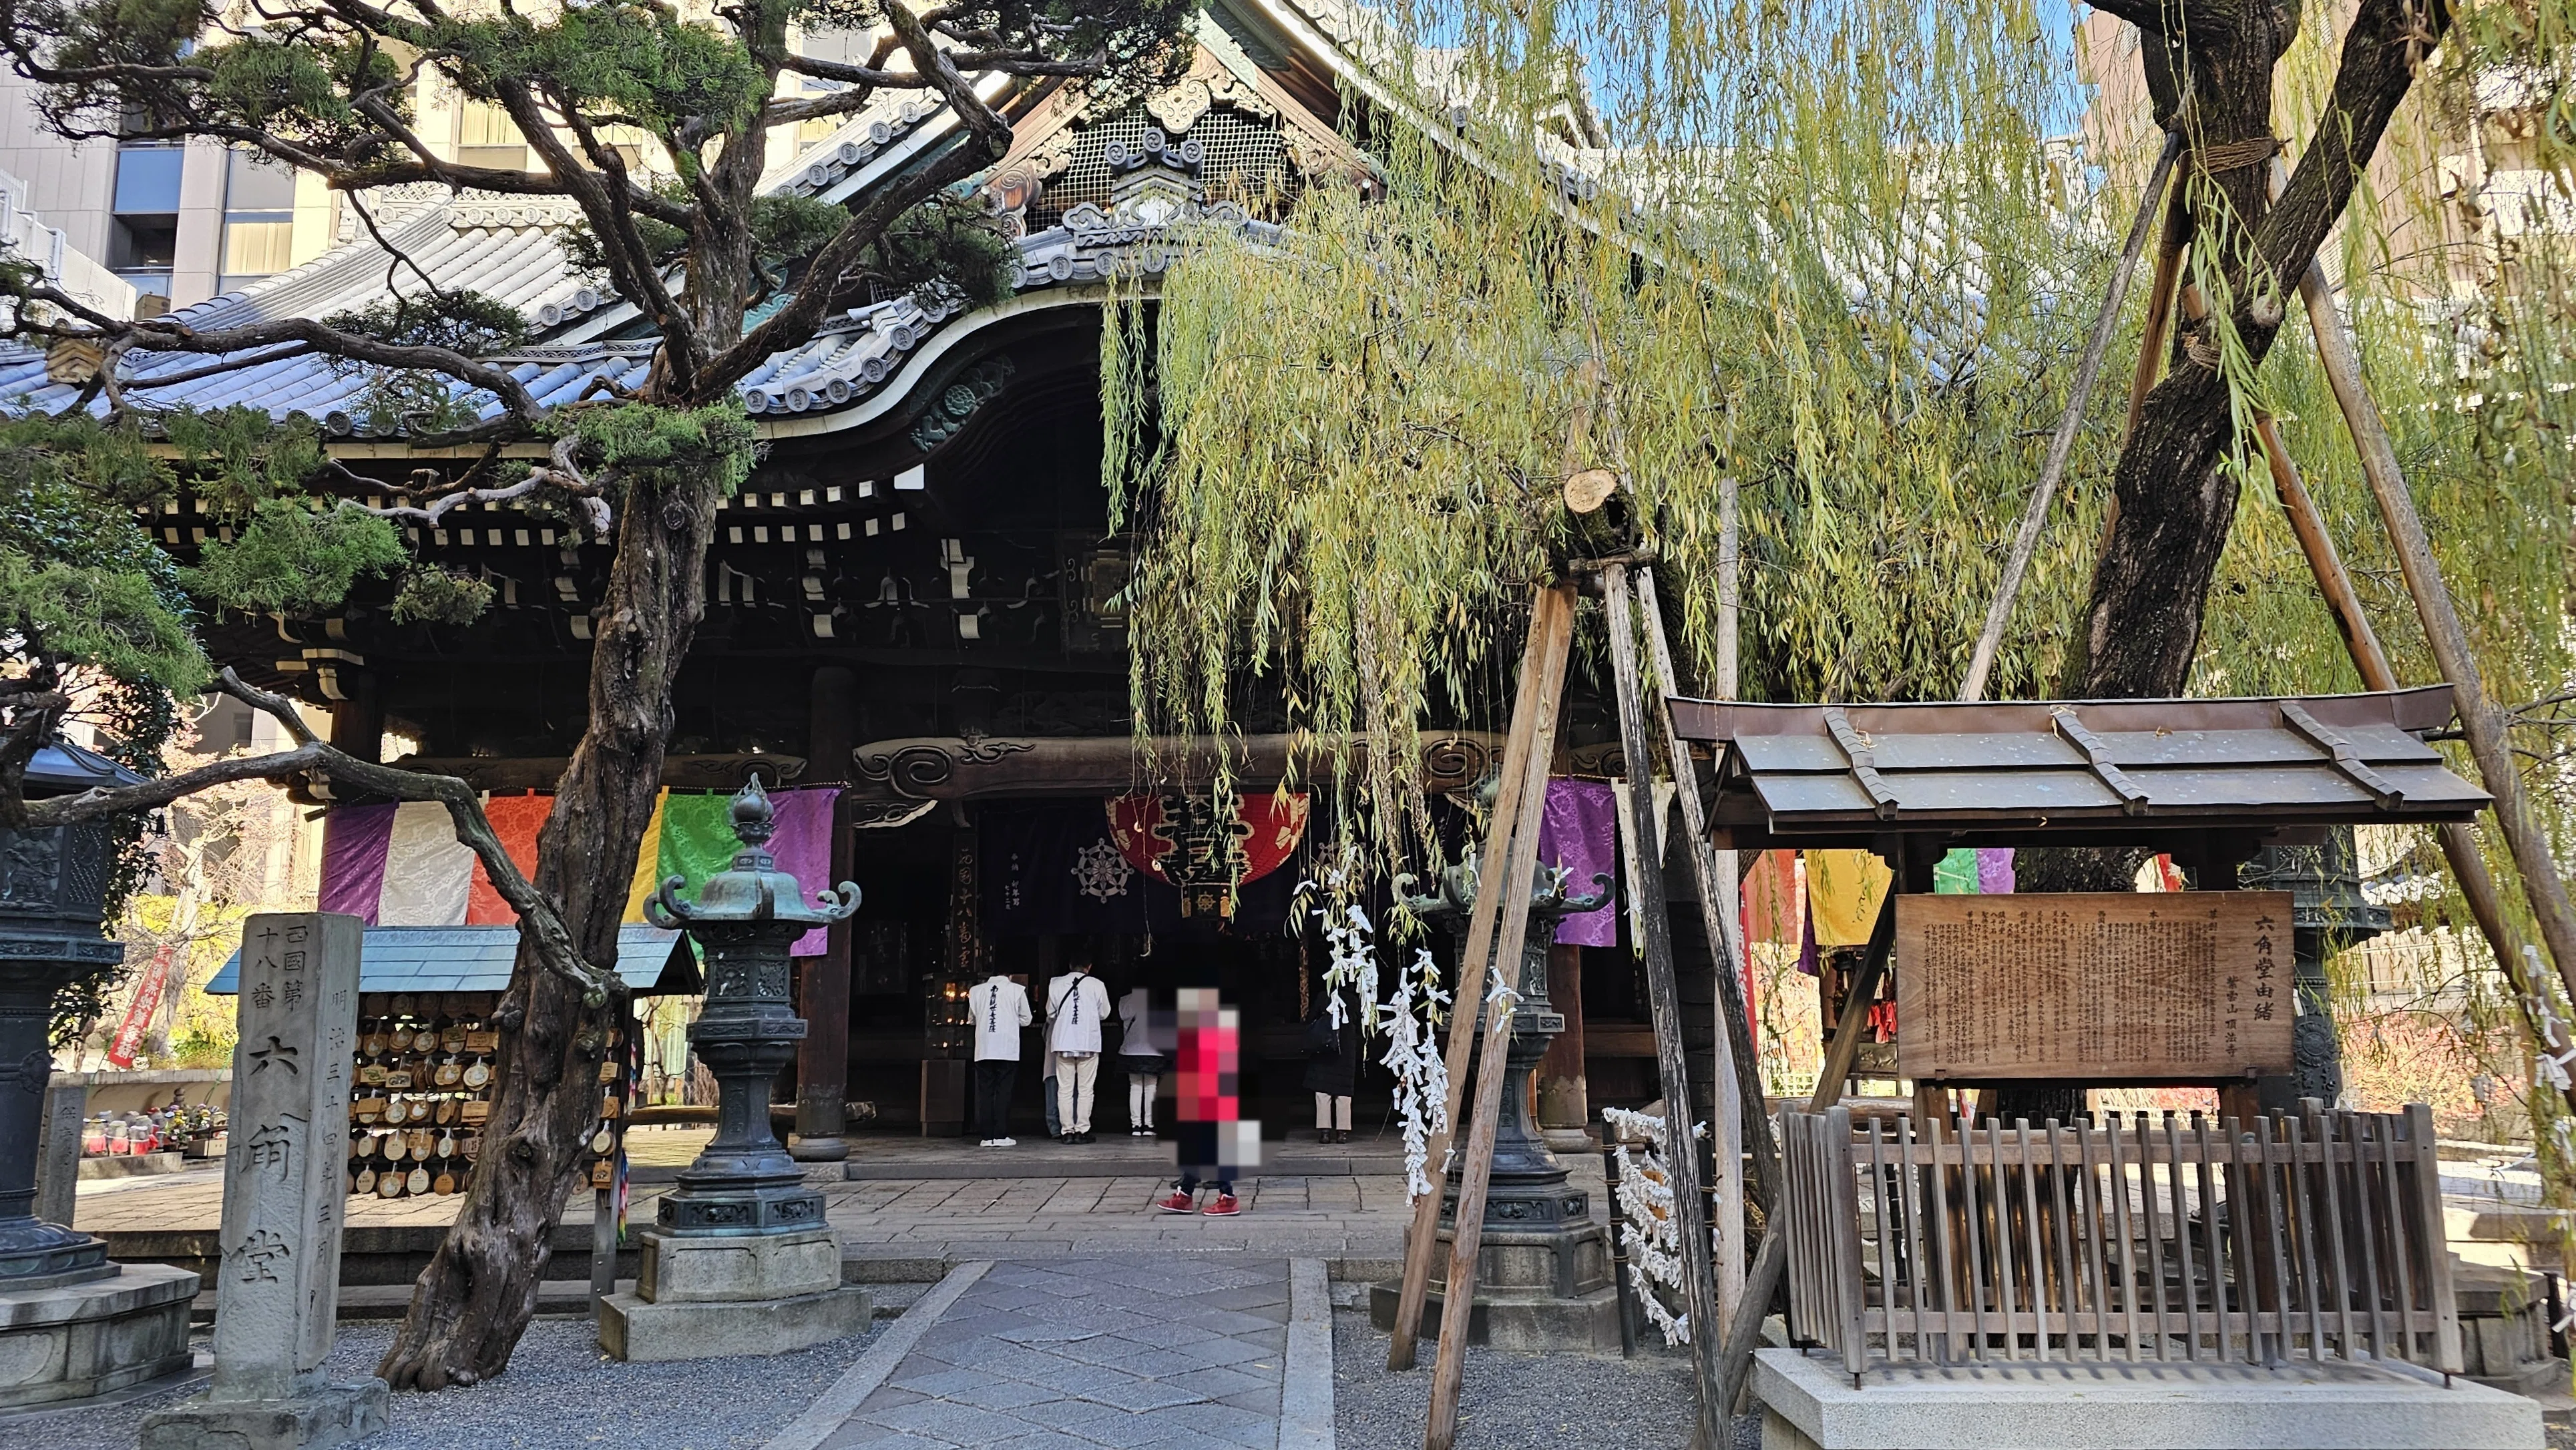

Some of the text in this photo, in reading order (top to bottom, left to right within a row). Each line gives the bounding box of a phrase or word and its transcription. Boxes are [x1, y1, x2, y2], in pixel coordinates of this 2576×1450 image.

[251, 927, 279, 1009] 十八番
[2253, 915, 2276, 1022] 六角堂由緒
[239, 1035, 299, 1283] 六角堂
